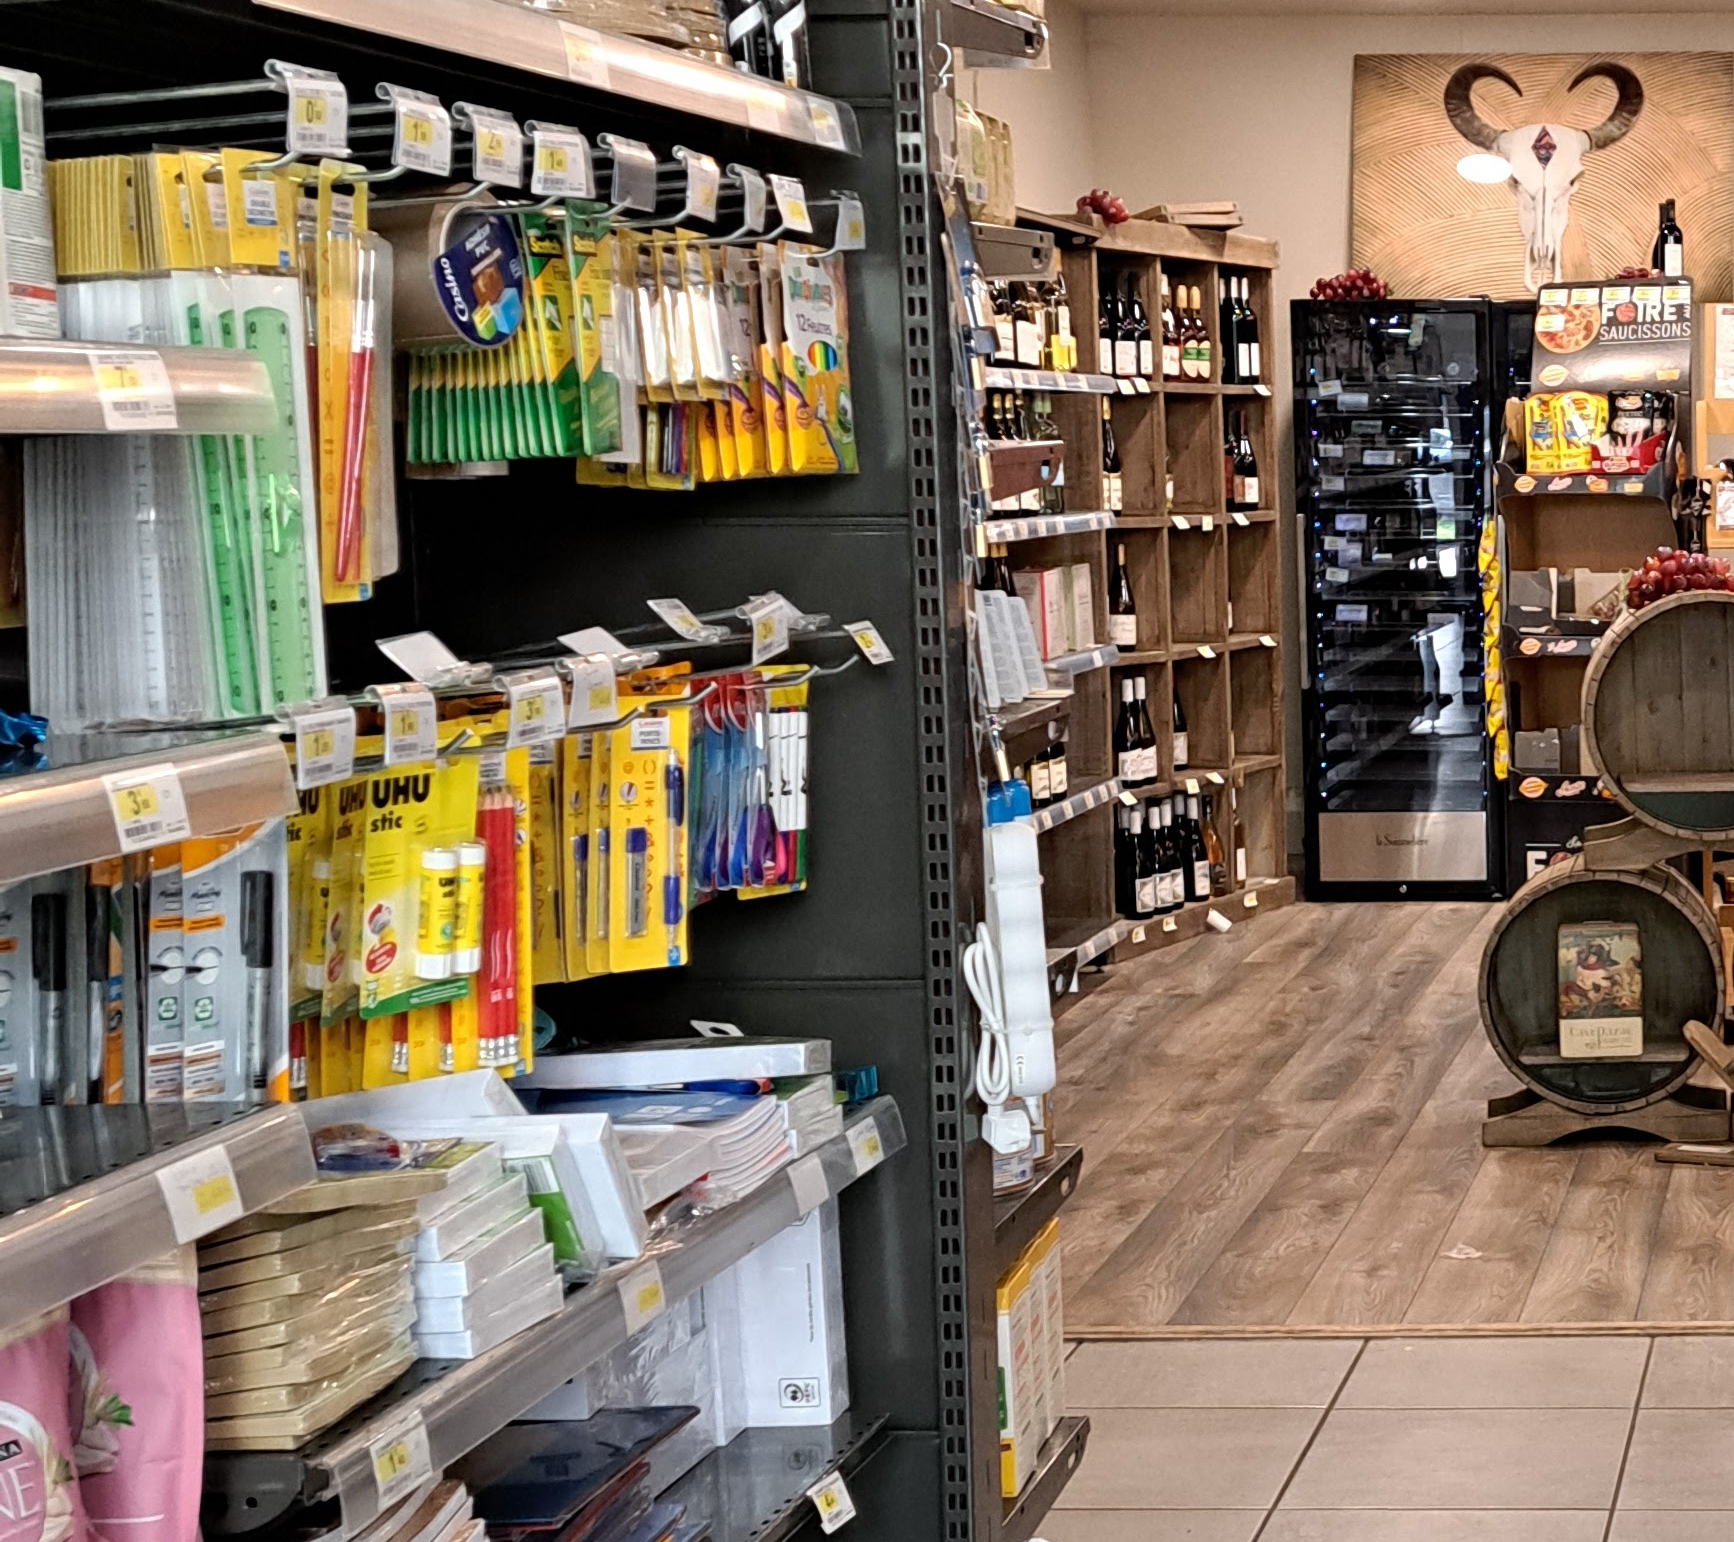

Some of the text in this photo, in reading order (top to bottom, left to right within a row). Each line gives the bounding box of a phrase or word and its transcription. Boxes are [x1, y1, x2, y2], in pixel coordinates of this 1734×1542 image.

[439, 258, 469, 323] Casino
[1600, 322, 1692, 342] SAUCISSONS
[372, 774, 431, 809] UHU
[370, 813, 403, 834] stic
